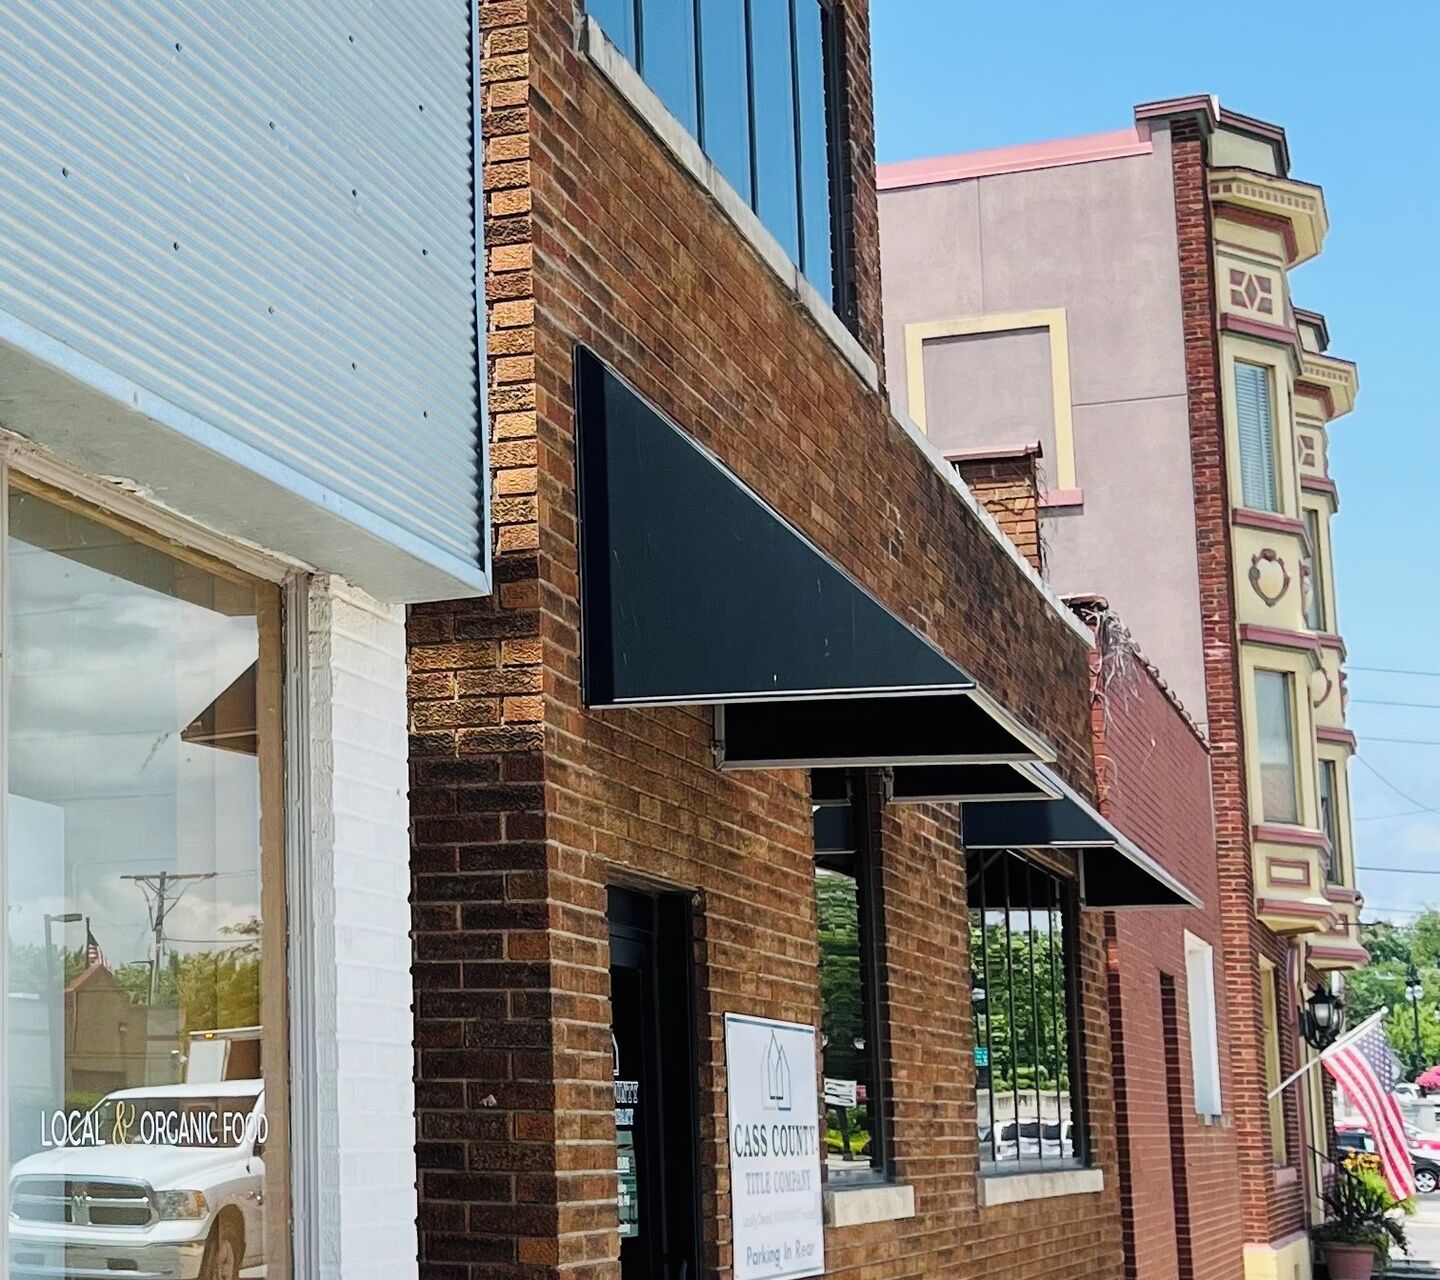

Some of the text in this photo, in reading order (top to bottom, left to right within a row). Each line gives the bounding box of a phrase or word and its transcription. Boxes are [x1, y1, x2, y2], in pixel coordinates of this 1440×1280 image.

[40, 1099, 269, 1148] LOCAL & ORGANIC FOOD
[734, 1123, 816, 1158] CASS COUNTY
[745, 1171, 771, 1196] TITLE
[746, 1239, 815, 1269] Parking In Rear
